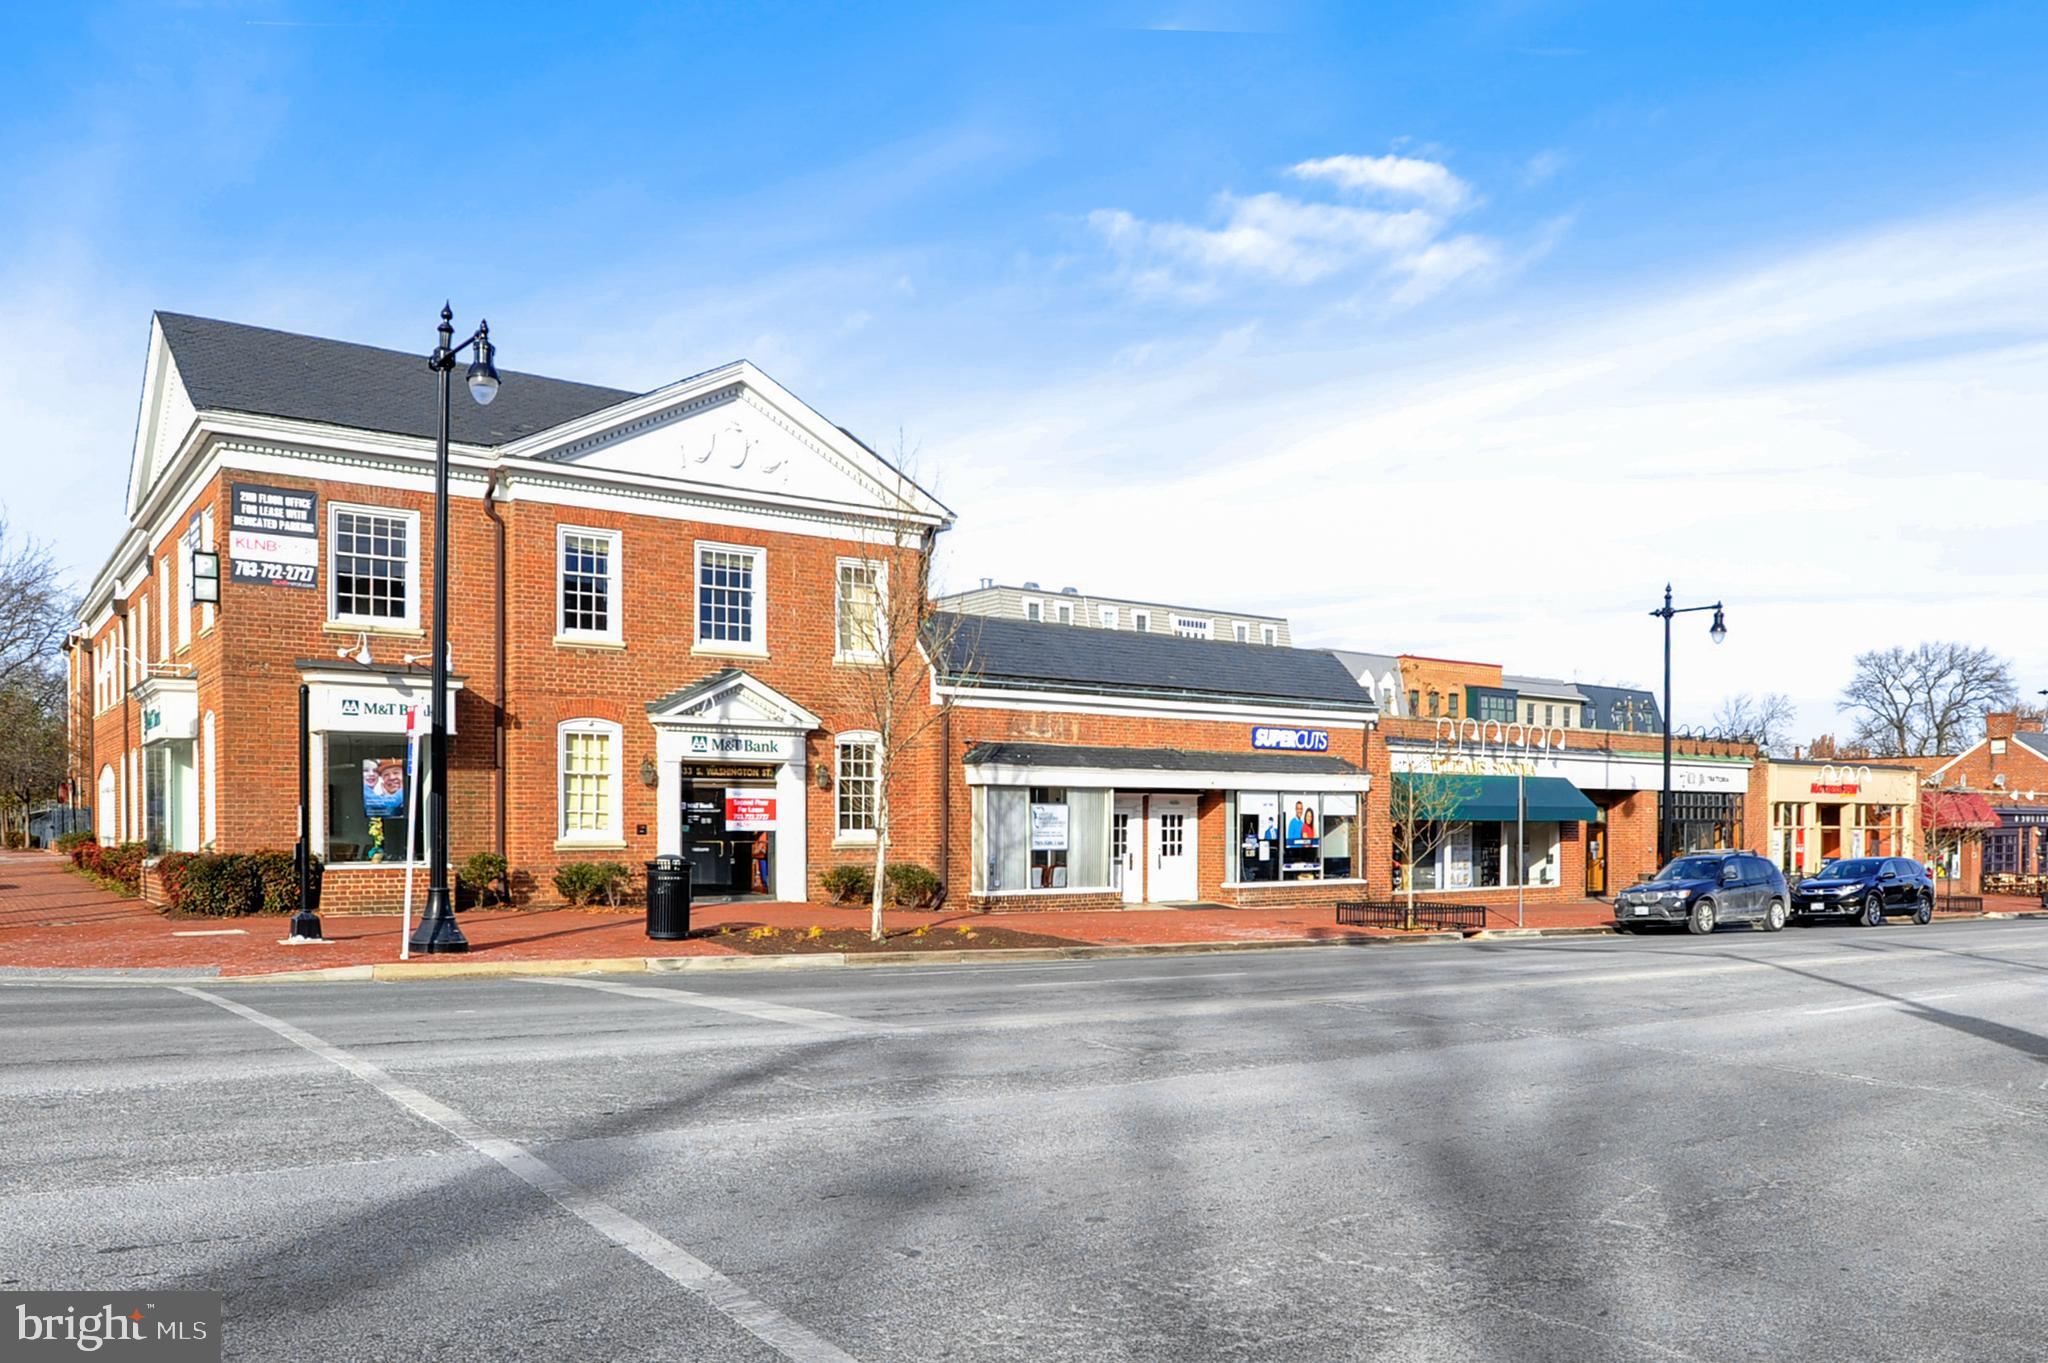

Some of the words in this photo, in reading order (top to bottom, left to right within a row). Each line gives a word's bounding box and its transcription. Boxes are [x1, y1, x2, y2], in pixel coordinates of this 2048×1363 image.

[258, 493, 284, 506] FLOOR
[284, 496, 312, 509] OFFICE
[241, 504, 258, 515] FOR
[259, 505, 285, 518] LEASE
[233, 515, 278, 529] DEDICATED
[278, 520, 315, 533] PARKING
[235, 537, 278, 552] KLNB
[235, 560, 315, 582] 703-722-2727
[364, 702, 396, 715] M&T
[711, 738, 742, 751] M&T
[744, 739, 778, 752] Bank
[1254, 728, 1328, 750] SUPERCUTS
[706, 767, 759, 777] WASHINGTON
